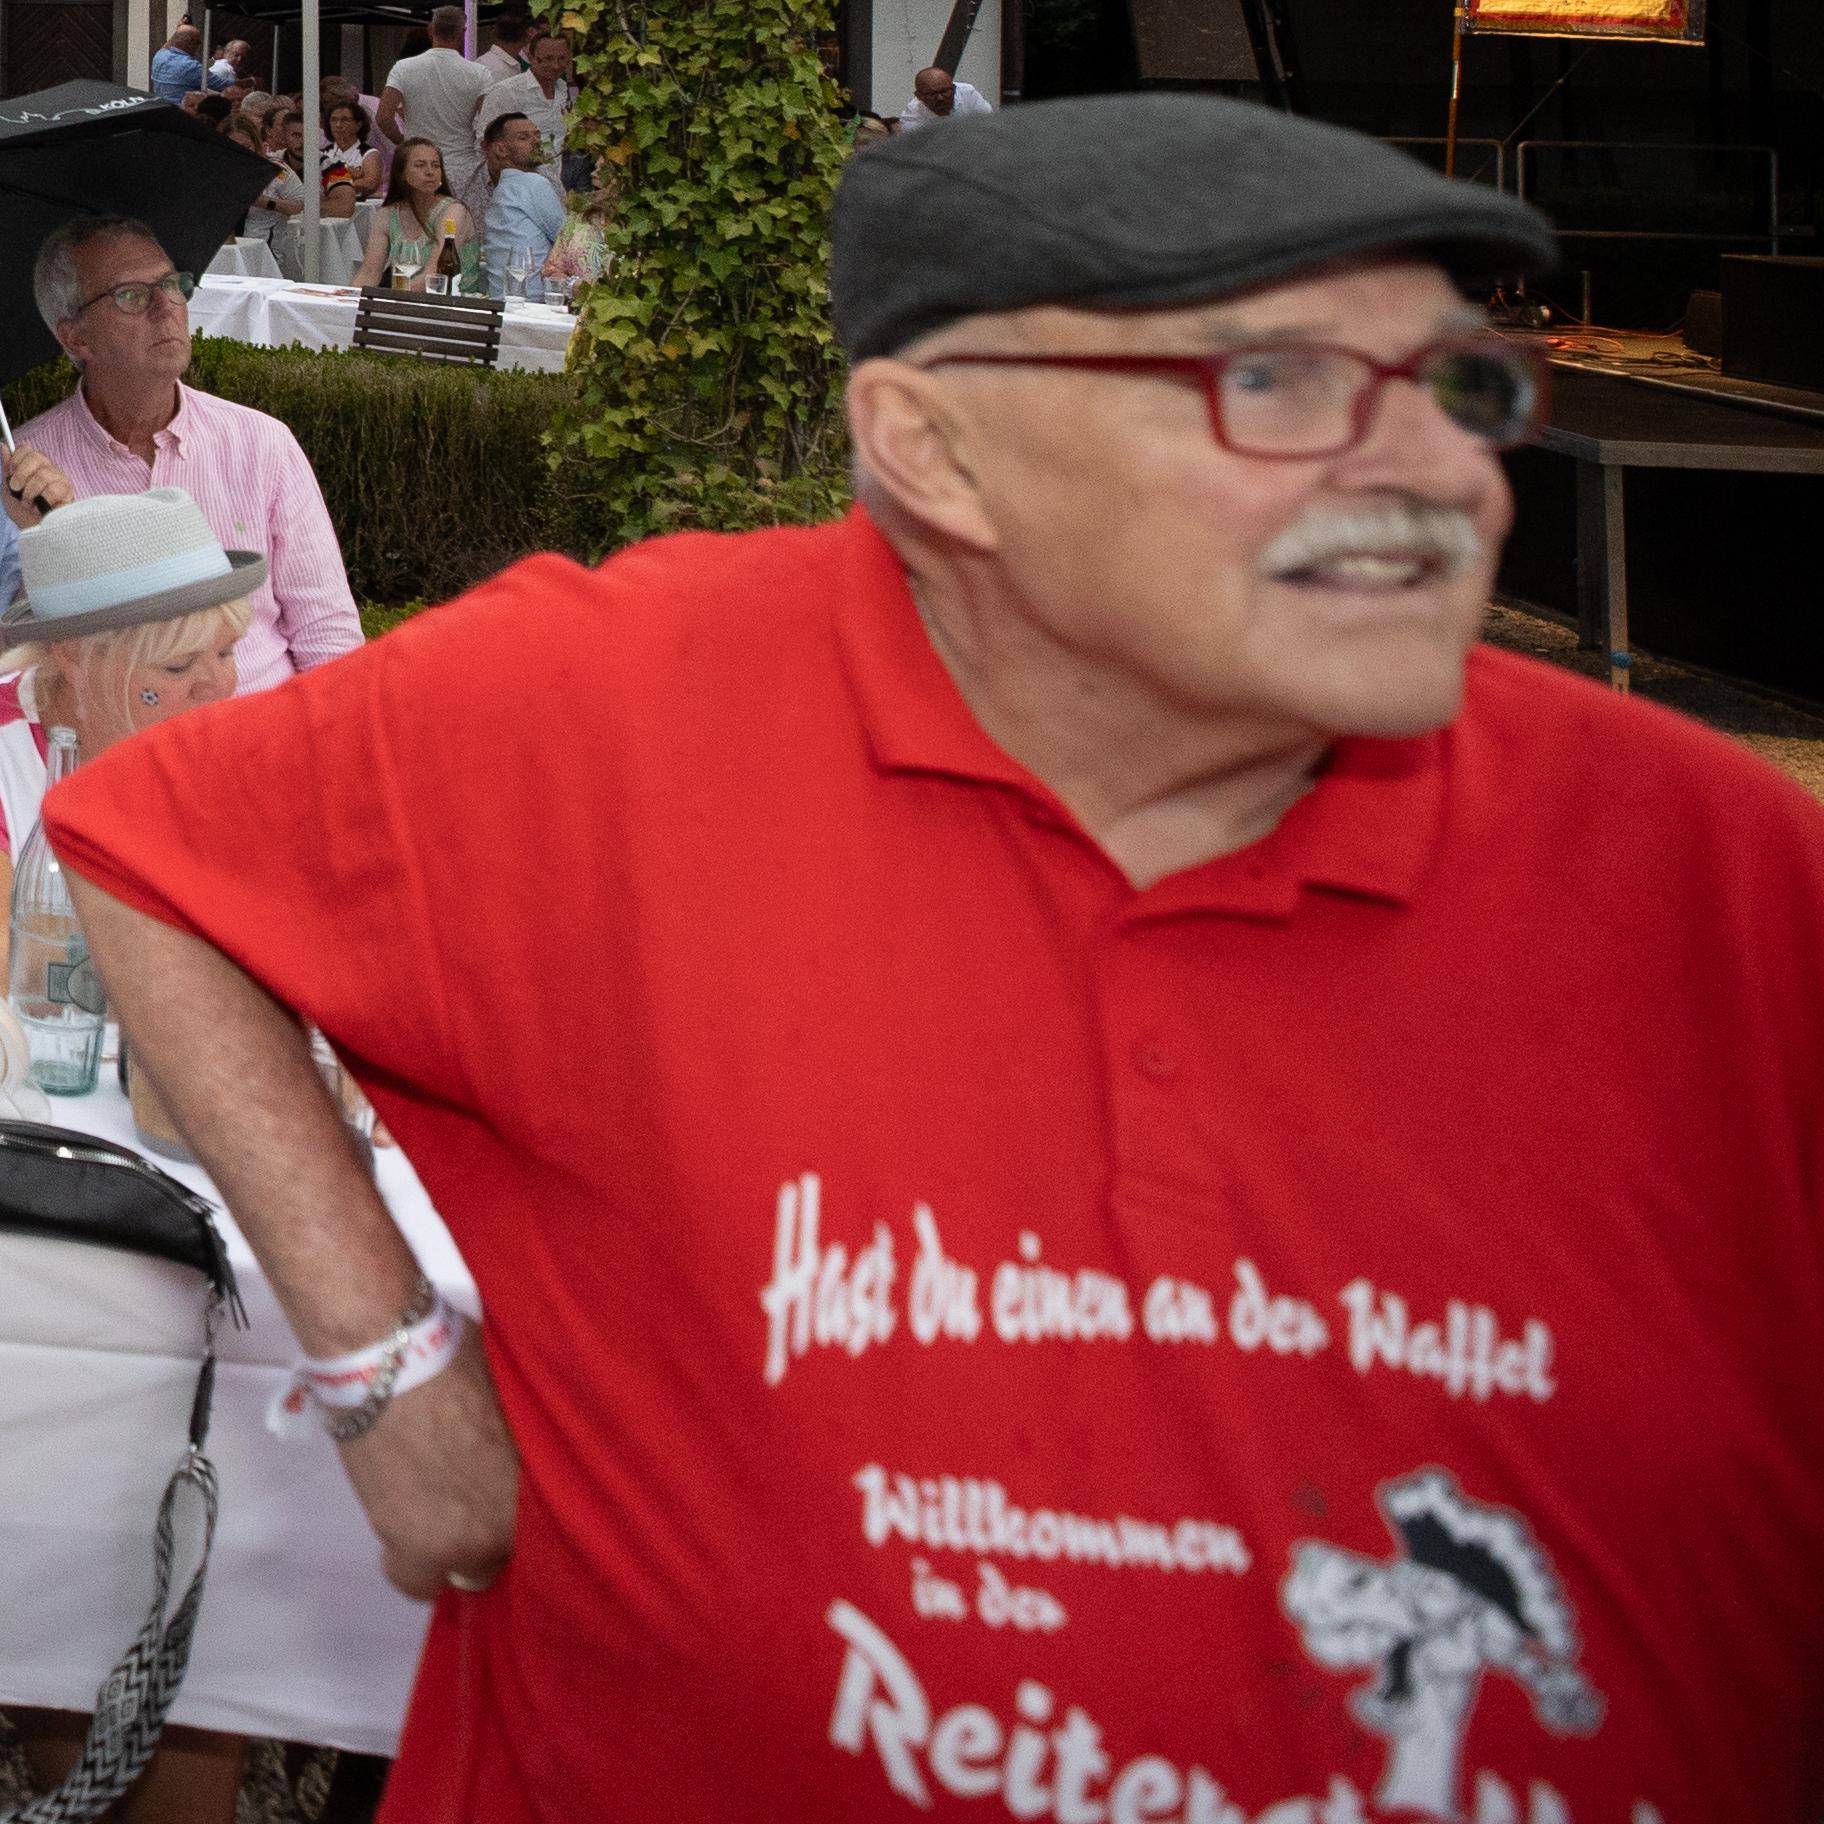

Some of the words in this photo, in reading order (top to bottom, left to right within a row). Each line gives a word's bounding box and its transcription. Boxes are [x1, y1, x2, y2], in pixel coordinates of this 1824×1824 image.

[760, 1172, 896, 1386] Hast
[909, 1200, 980, 1346] du
[990, 1228, 1133, 1346] einen
[1142, 1275, 1217, 1346] an
[1228, 1255, 1331, 1360] der
[1338, 1278, 1555, 1402] Waffel
[854, 1462, 1251, 1576] Willkommen
[911, 1556, 967, 1621] in
[976, 1560, 1068, 1634] der
